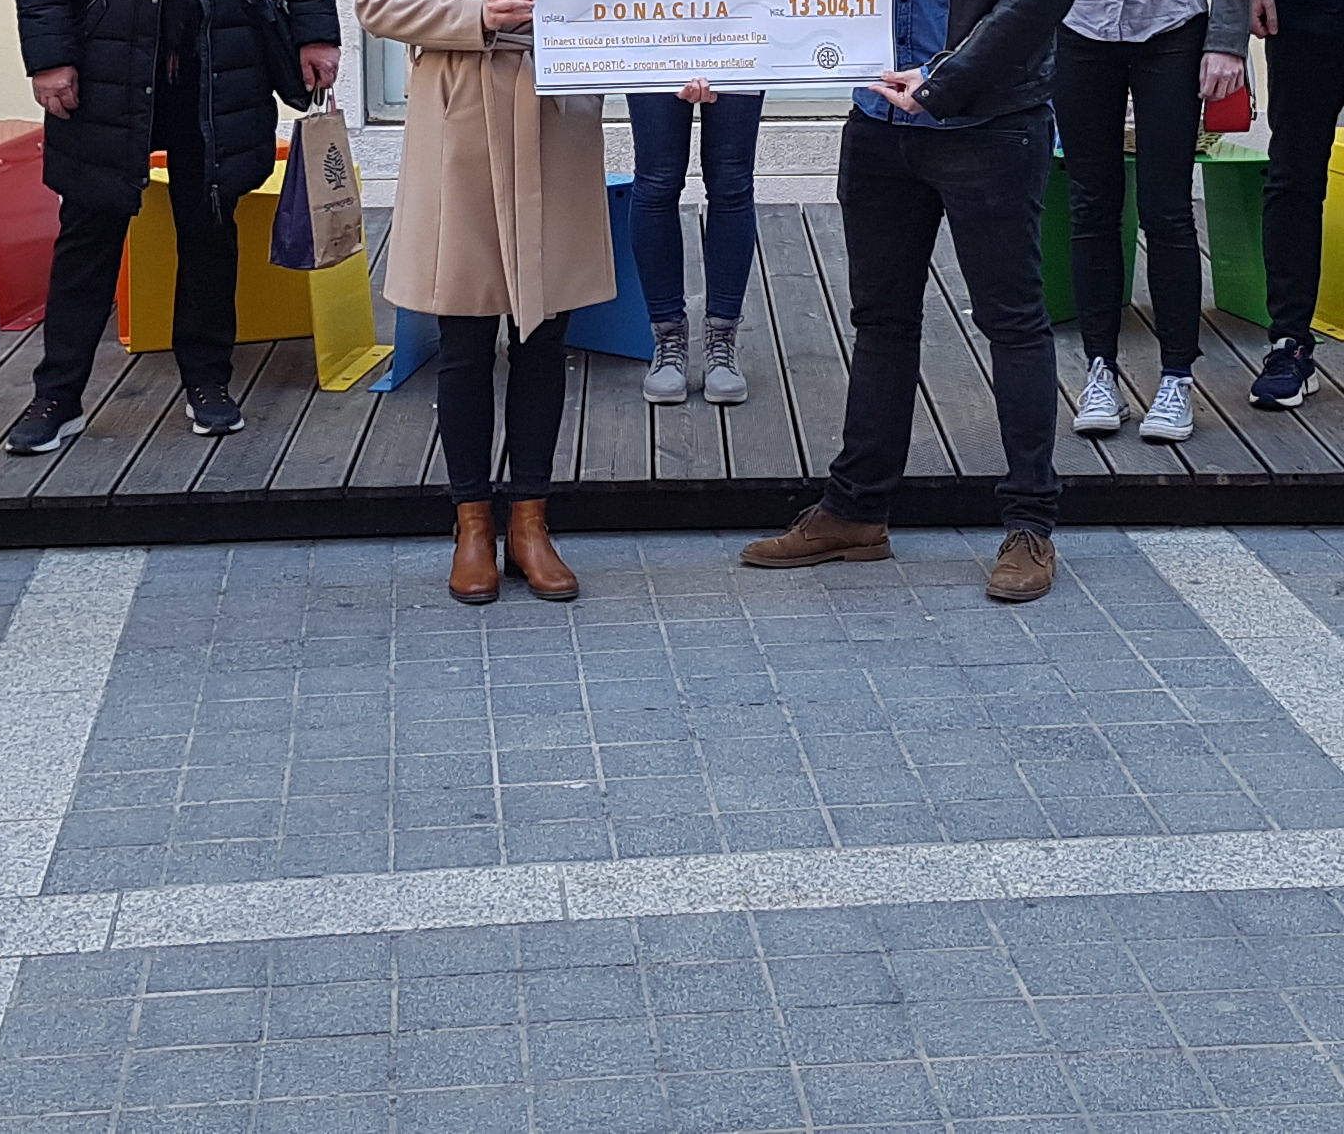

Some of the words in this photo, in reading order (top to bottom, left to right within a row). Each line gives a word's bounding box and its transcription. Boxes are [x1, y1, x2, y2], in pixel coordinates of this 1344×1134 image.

[593, 1, 729, 20] DONACIJA
[543, 37, 576, 46] Trinaest
[605, 36, 619, 47] pet
[621, 34, 651, 44] stotina
[658, 34, 680, 43] četiri
[681, 33, 702, 43] kune
[709, 33, 749, 44] jedanaest
[751, 32, 767, 44] lipa
[552, 62, 591, 72] UDRUGA
[633, 61, 666, 72] program
